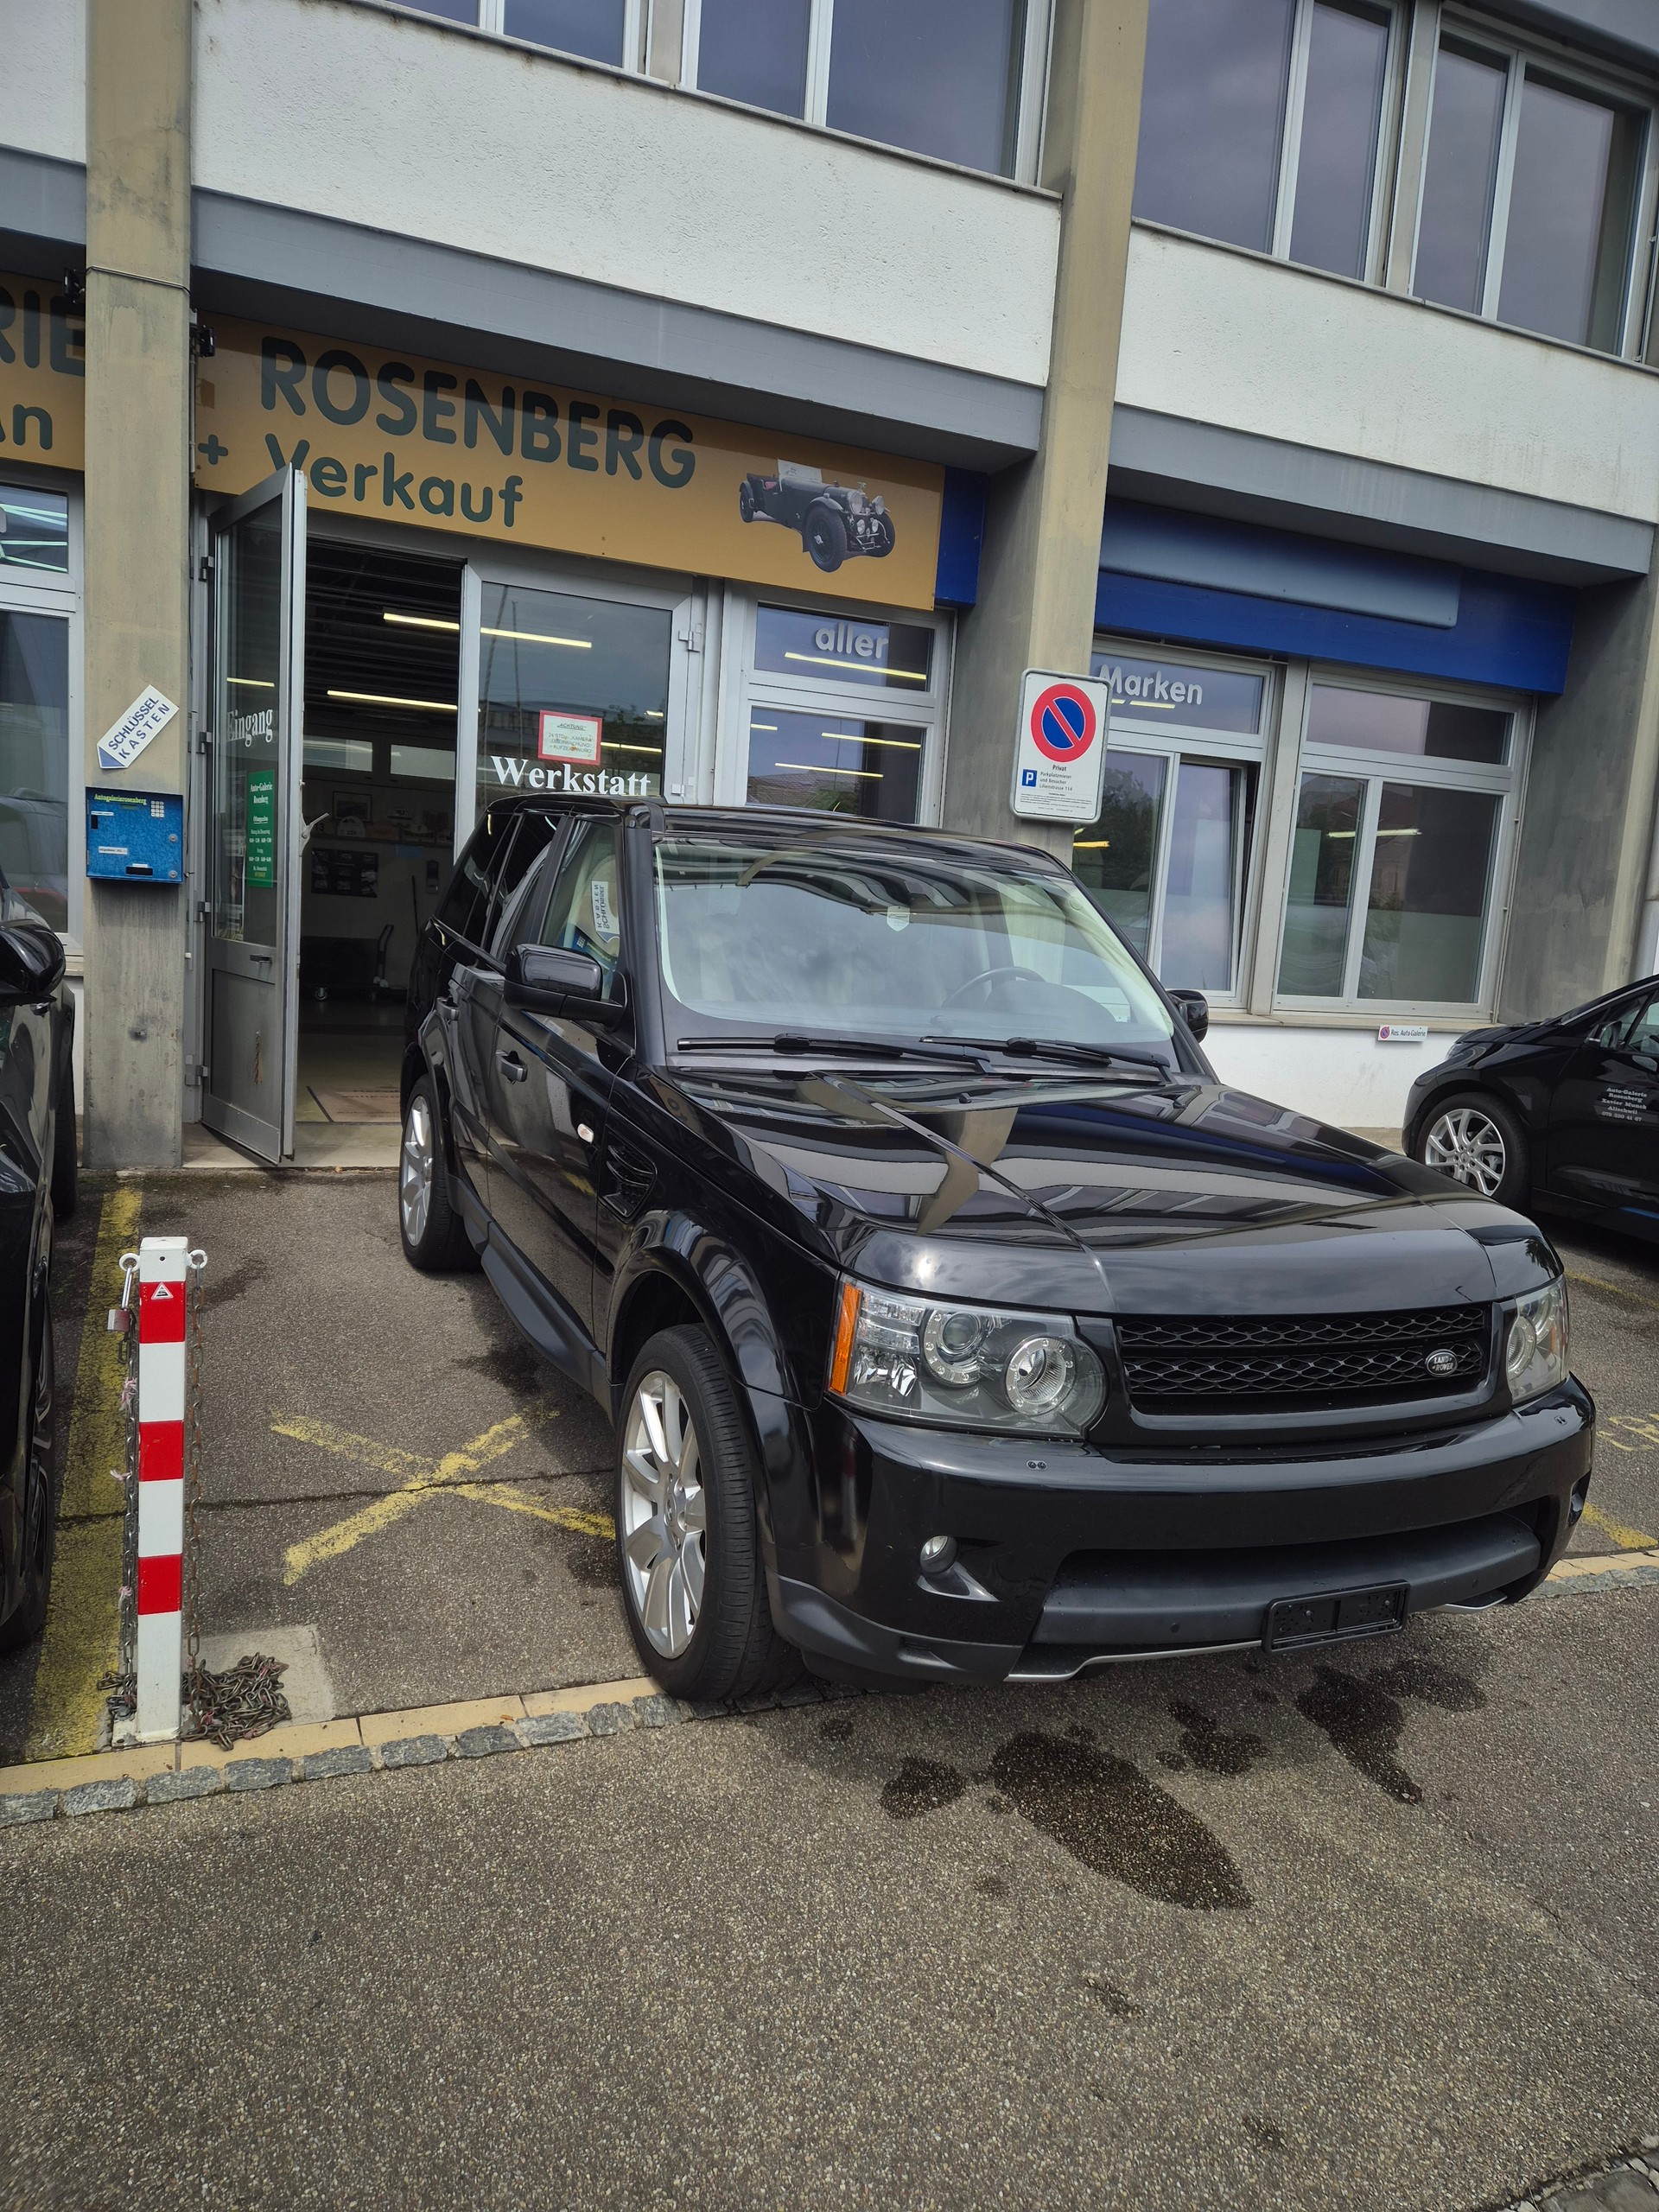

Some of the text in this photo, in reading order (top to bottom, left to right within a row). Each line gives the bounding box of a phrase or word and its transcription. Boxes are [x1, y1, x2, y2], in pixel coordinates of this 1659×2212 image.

[261, 336, 696, 489] ROSENBERG
[265, 433, 524, 528] Verkauf
[815, 621, 1203, 705] aller Marken
[108, 697, 159, 750] SCHLÜSSEL
[118, 703, 170, 760] KASTEN
[226, 709, 273, 747] Eingang
[490, 755, 652, 797] Werkstatt
[1026, 772, 1034, 785] P
[1606, 1087, 1648, 1098] Auto-Galerie
[1607, 1106, 1638, 1115] Allschwil
[1608, 1092, 1643, 1103] Rosenberg
[1434, 1363, 1453, 1371] ROVER
